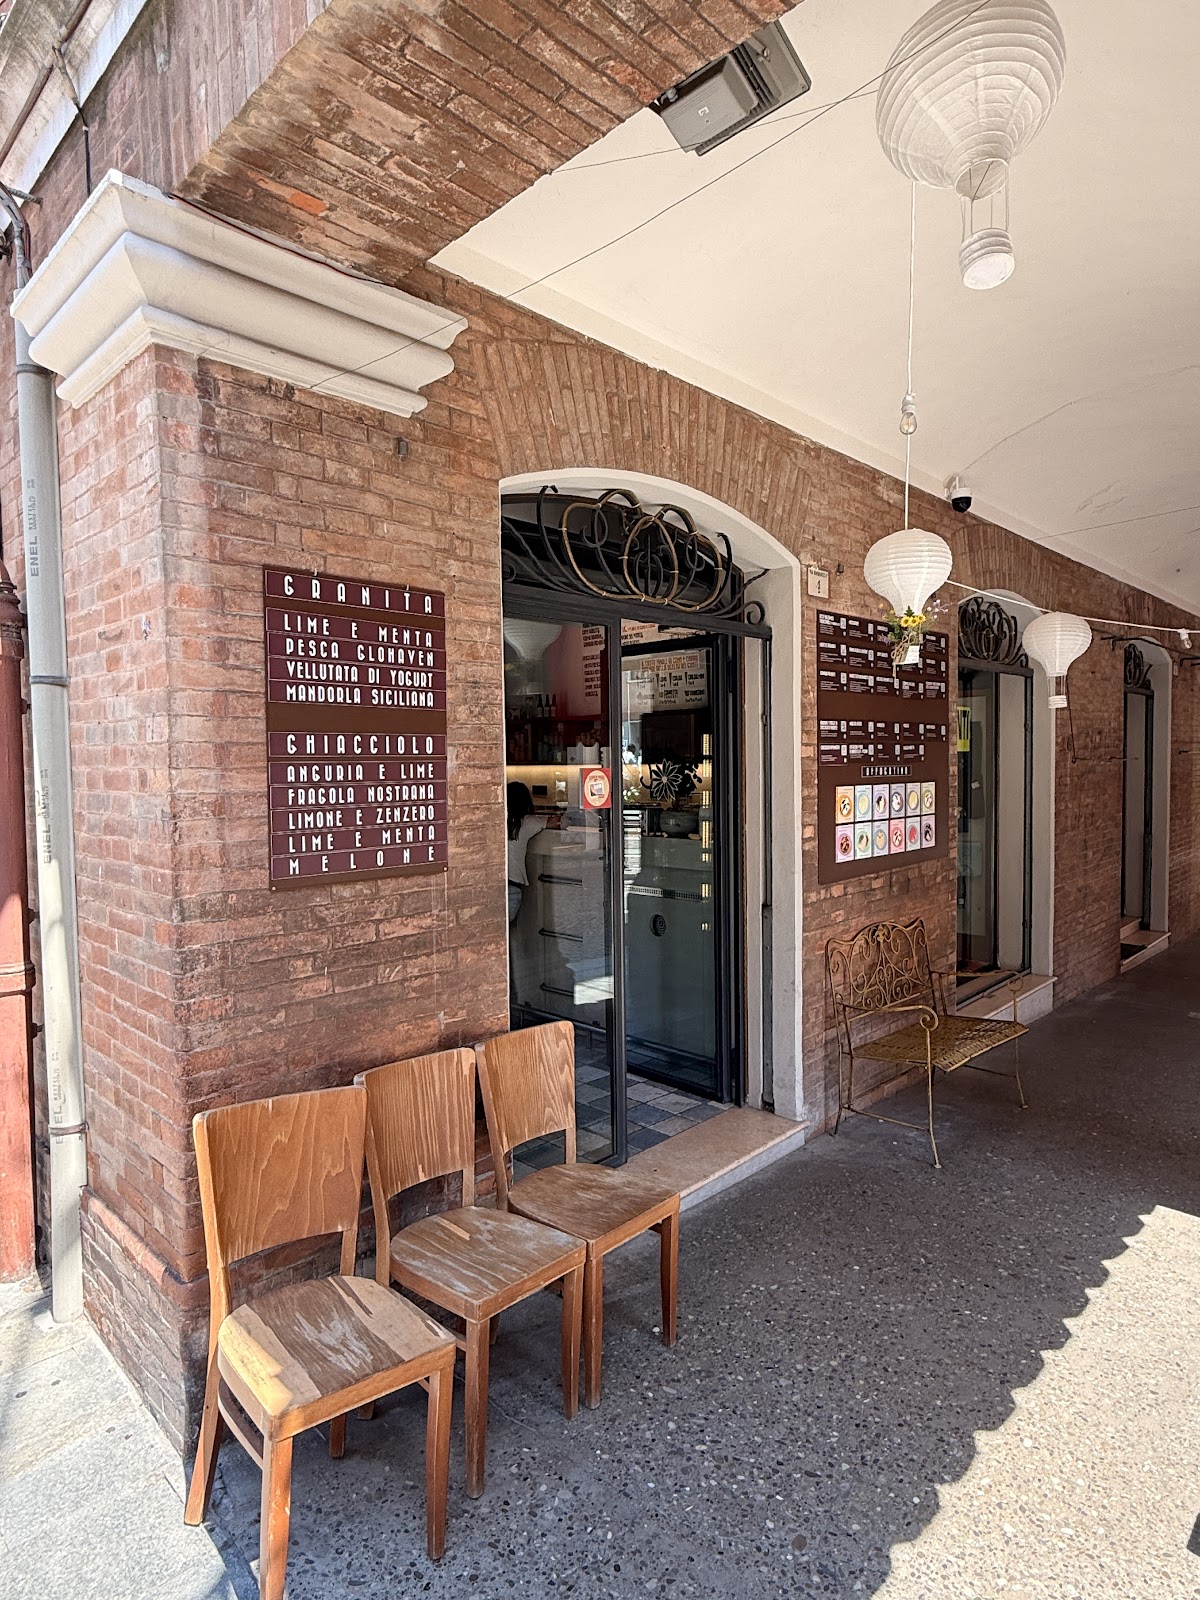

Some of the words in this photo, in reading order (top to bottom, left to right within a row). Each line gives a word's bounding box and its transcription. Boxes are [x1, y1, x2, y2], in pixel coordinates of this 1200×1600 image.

[29, 536, 39, 577] ENEL
[284, 575, 432, 614] GRANITA
[284, 613, 330, 636] LIME
[351, 622, 358, 639] E
[378, 626, 432, 648] MENTA
[285, 638, 339, 658] PESCA
[357, 645, 434, 667] GLOHAVEN
[286, 661, 358, 683] VELLUTATA
[368, 668, 380, 684] DI
[390, 670, 433, 688] YOGURT
[286, 684, 361, 704] MANDORLA
[371, 688, 434, 708] SICILIANA
[286, 734, 433, 755] GHIACCIOLO
[287, 764, 363, 783] ANGURIA
[379, 764, 386, 780] E
[401, 763, 434, 780] LIME
[288, 787, 355, 806] FRAGOLA
[367, 784, 434, 803] NOSTRANA
[288, 810, 343, 829] LIMONE
[356, 809, 363, 826] E
[376, 805, 434, 824] ZENZERO
[42, 824, 52, 864] ENEL
[288, 833, 334, 853] LIME
[355, 831, 362, 847] E
[382, 825, 435, 845] MENTA
[289, 846, 434, 875] MELONE
[54, 1107, 63, 1144] EEL
